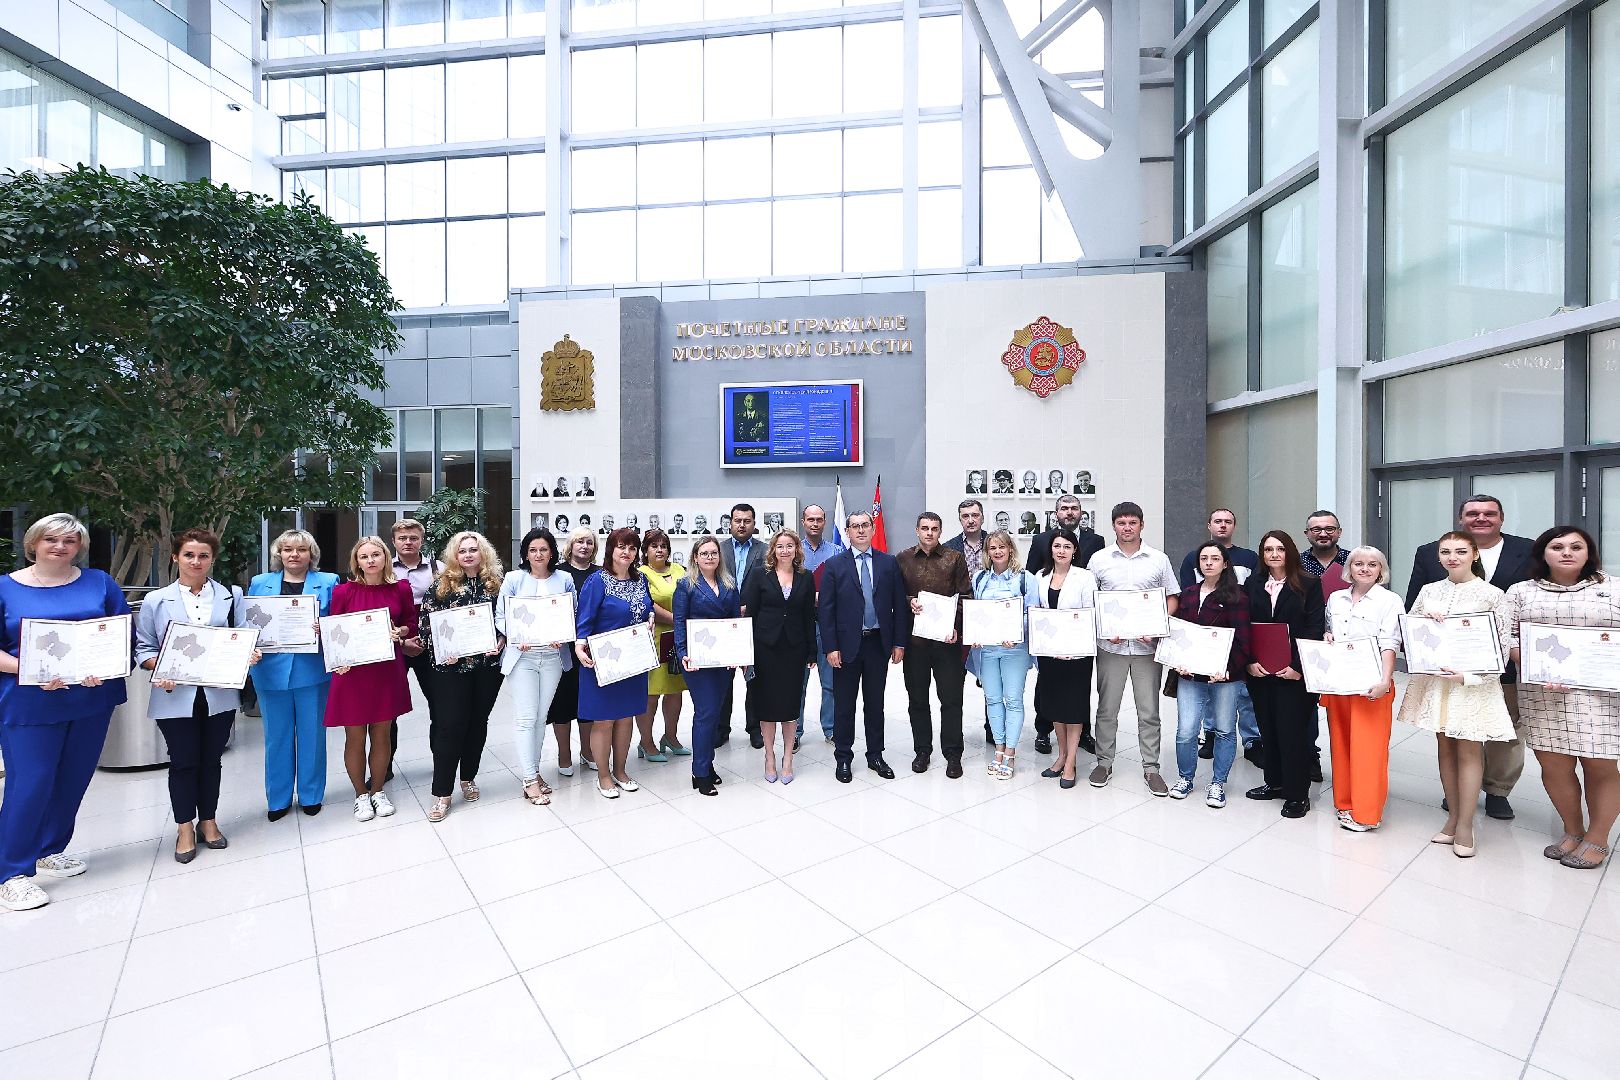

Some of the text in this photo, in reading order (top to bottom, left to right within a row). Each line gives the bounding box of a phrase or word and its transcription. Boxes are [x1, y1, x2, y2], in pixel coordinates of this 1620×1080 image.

[676, 315, 909, 338] ПОЧЕТНЫЕ ГРАЖДАНЕ
[672, 338, 913, 362] МОСКОВСКОЙ ОБЛАСТИ
